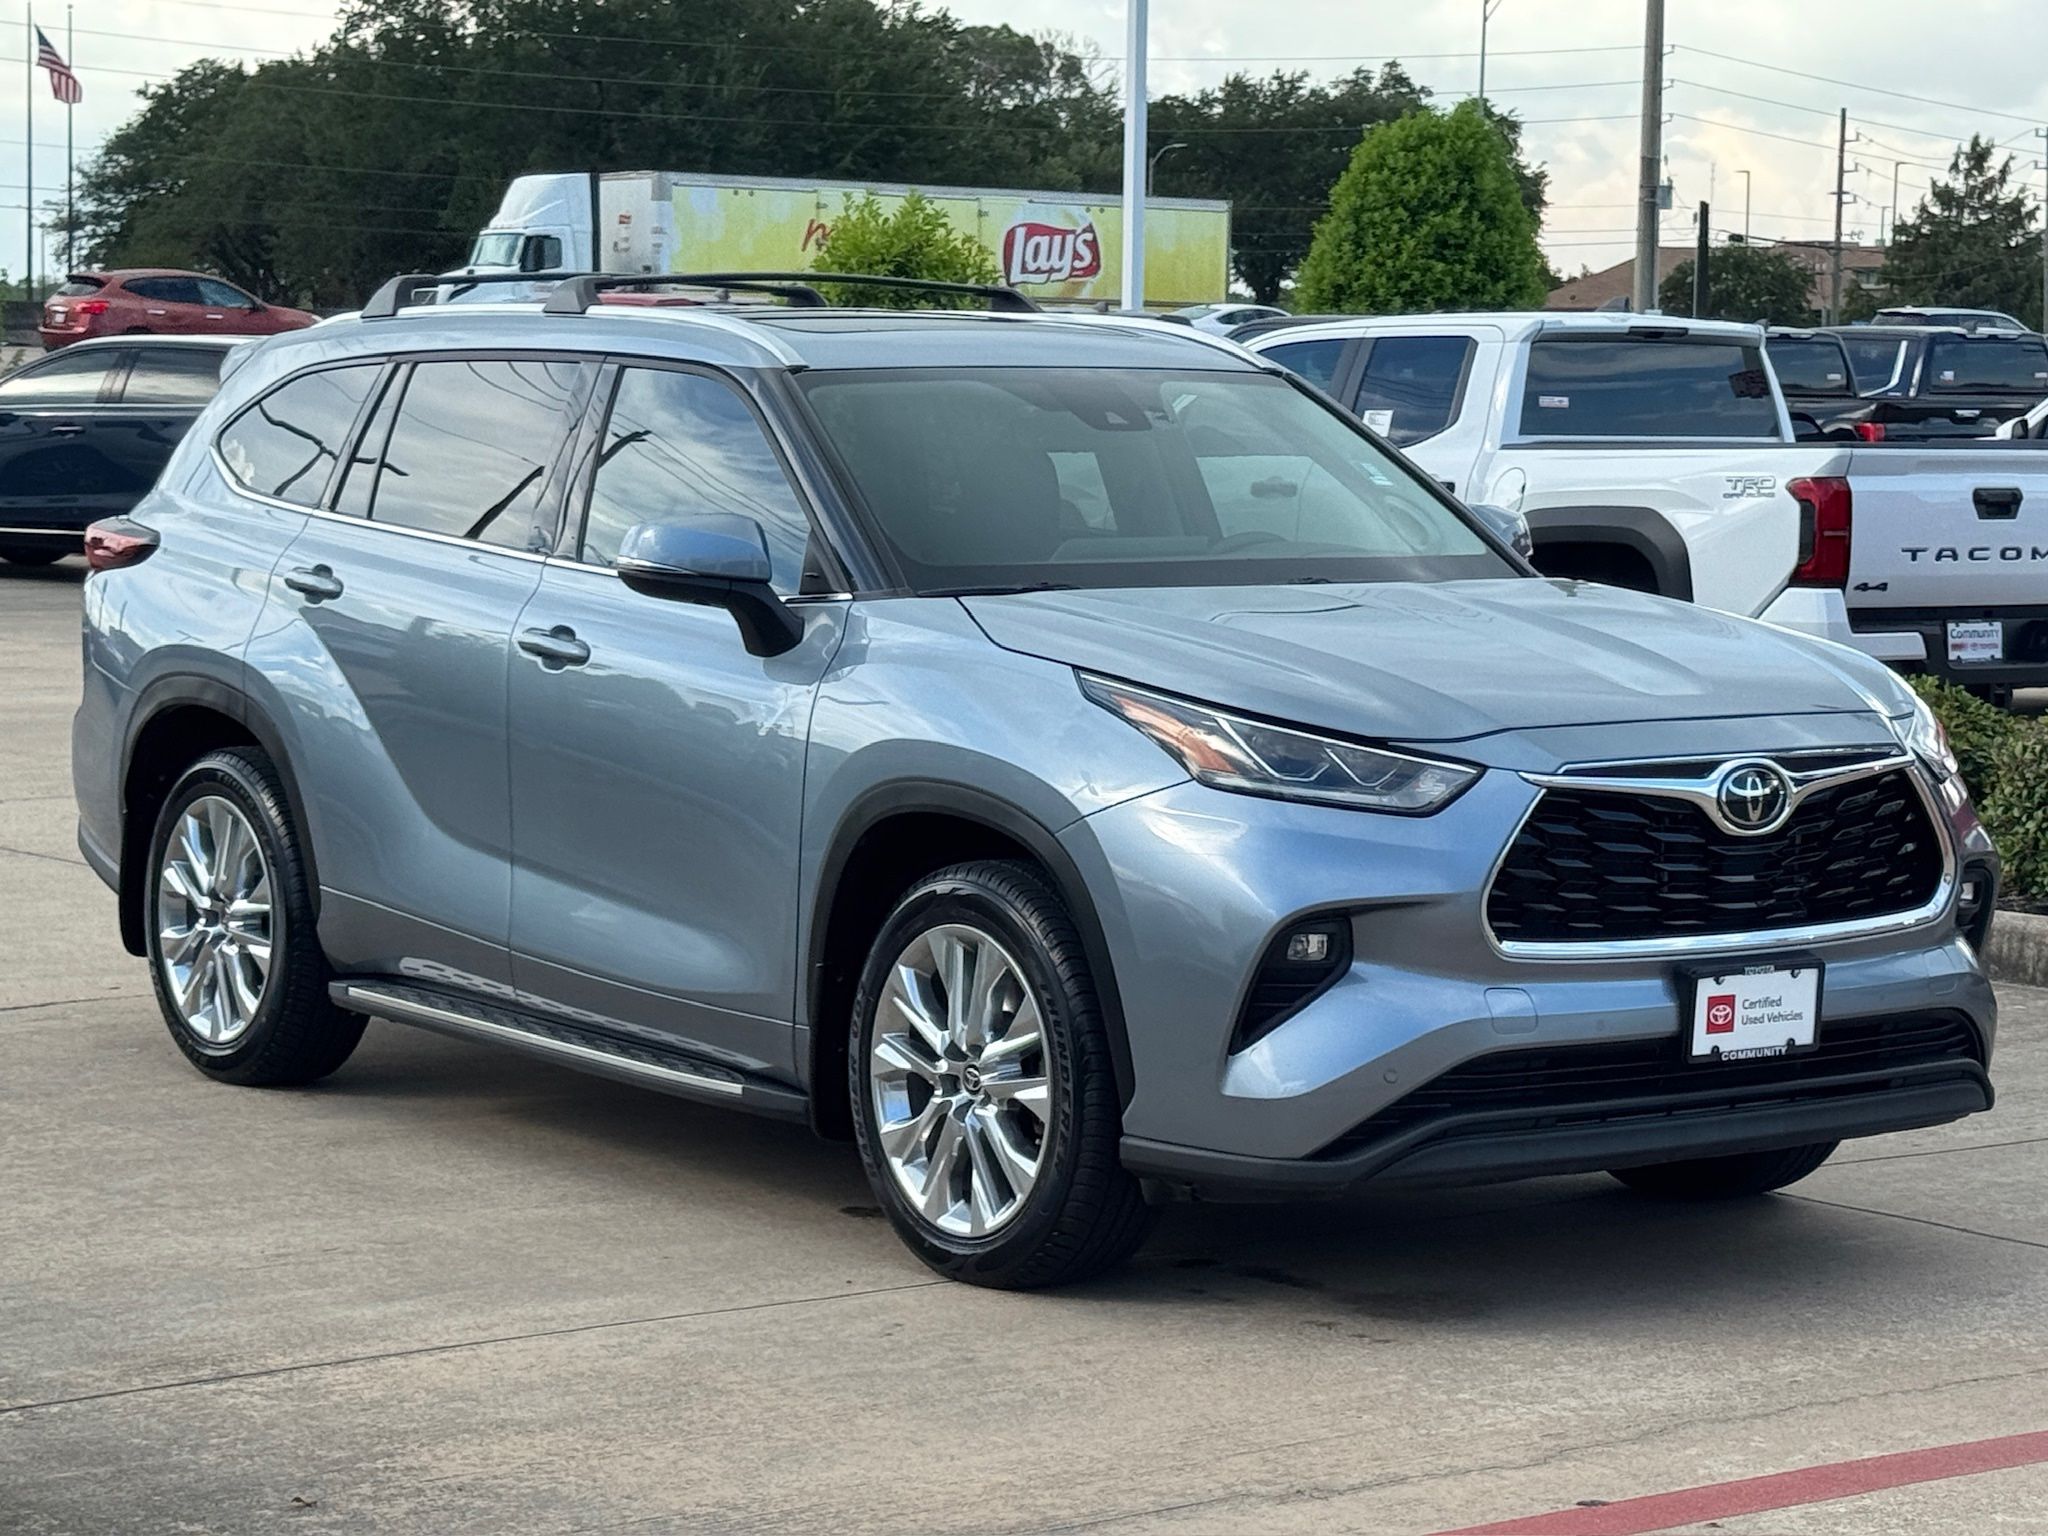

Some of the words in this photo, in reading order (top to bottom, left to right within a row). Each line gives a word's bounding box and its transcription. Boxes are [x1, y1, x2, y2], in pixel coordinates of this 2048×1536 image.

[1725, 476, 1777, 494] TRD
[1742, 996, 1783, 1010] Certified
[1741, 1015, 1766, 1026] Used
[1767, 1010, 1804, 1023] Vehicles
[1721, 1046, 1788, 1061] COMMUNITY
